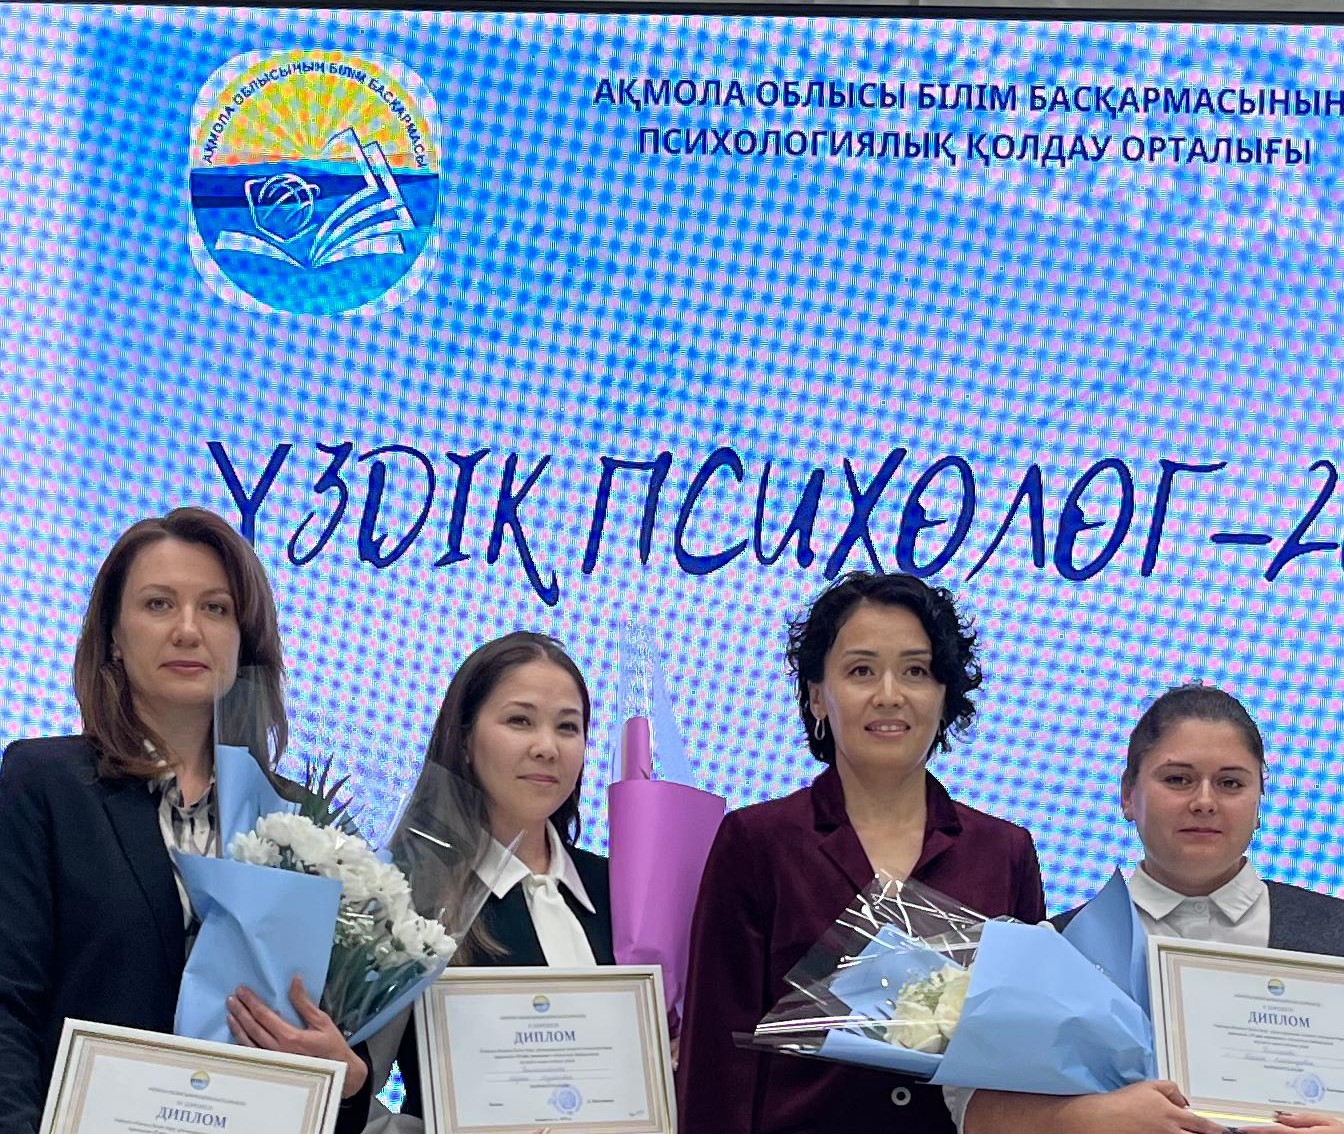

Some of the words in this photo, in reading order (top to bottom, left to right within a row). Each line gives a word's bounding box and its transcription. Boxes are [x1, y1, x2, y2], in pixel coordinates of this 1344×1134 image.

[593, 78, 746, 112] АҚМОЛА
[757, 80, 906, 109] ОБЛЫСЫ
[918, 82, 1017, 112] БІЛІМ
[639, 127, 958, 166] ПСИХОЛОГИЯЛЫҚ
[967, 133, 1111, 168] ҚОЛДАУ
[1121, 135, 1311, 165] ОРТАЛЫҒЫ
[1247, 1011, 1312, 1029] ДИПЛОМ
[513, 1030, 577, 1046] ДИПЛОМ
[155, 1105, 231, 1129] ДИПЛОМ
